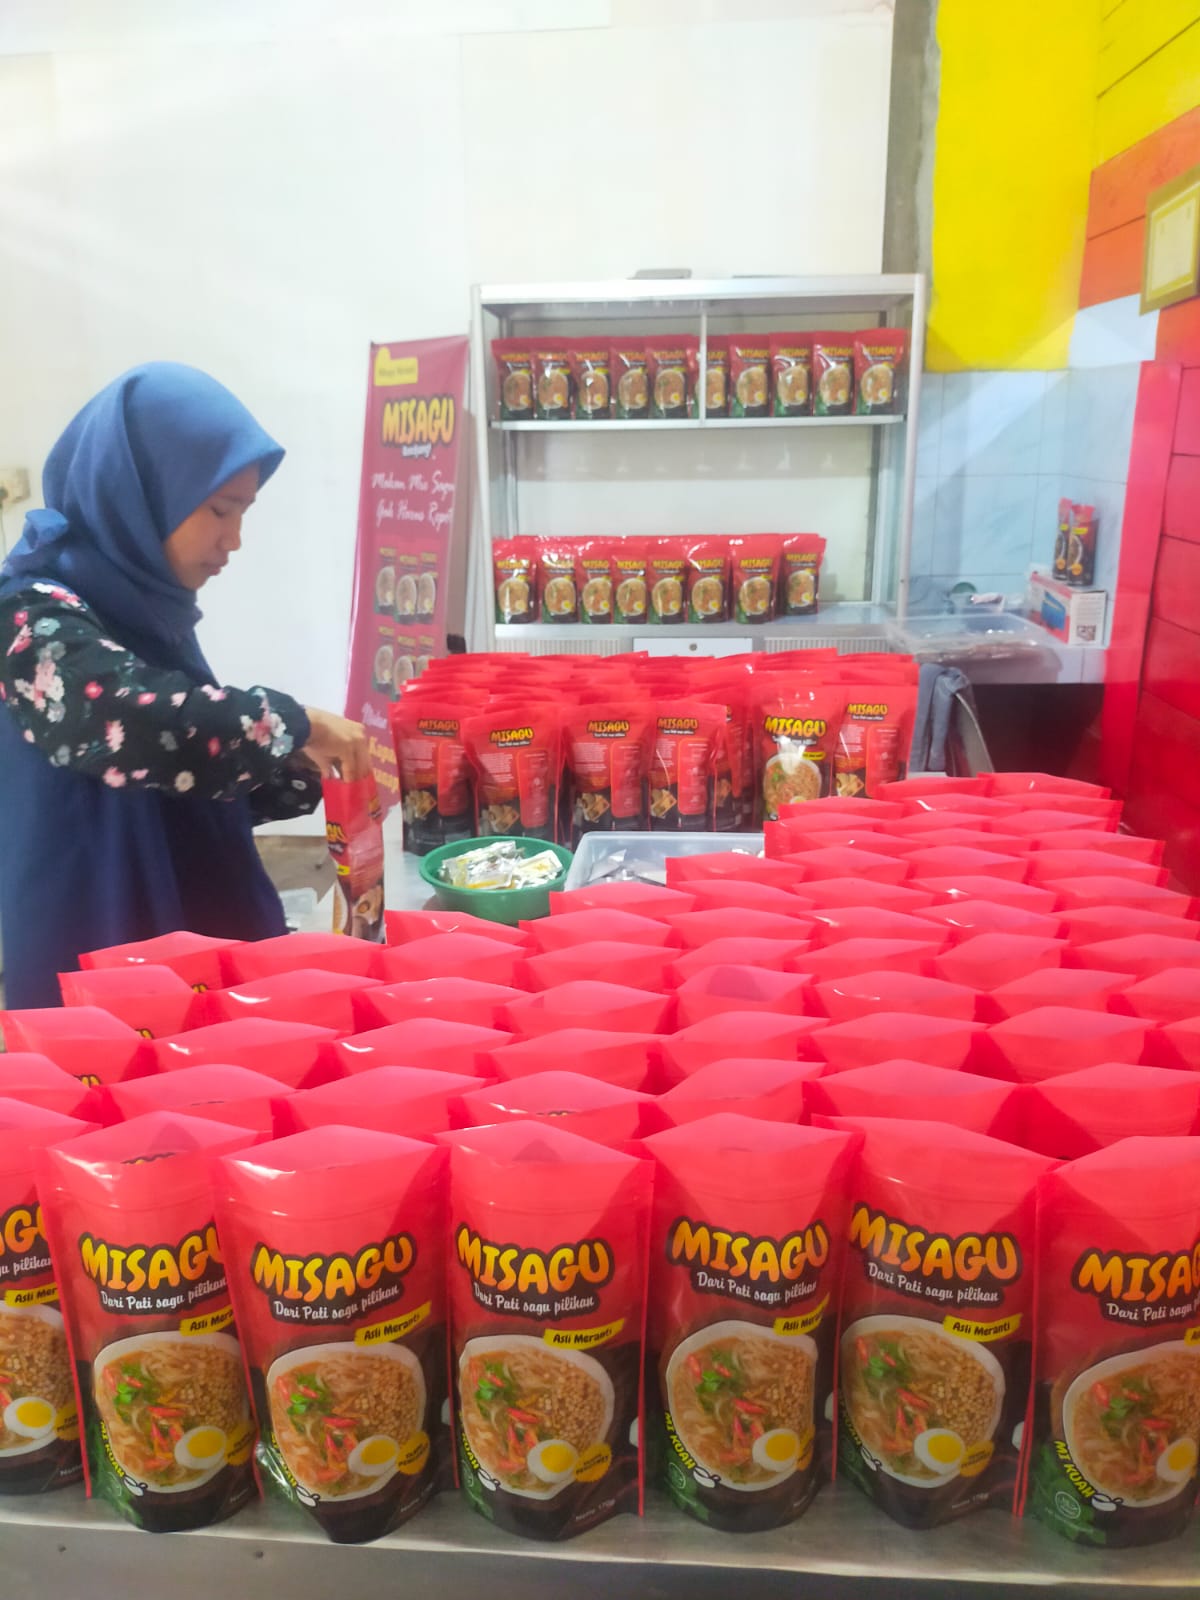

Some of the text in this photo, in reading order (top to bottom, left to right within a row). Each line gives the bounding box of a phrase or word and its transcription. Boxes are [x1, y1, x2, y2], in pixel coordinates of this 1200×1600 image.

[382, 397, 455, 445] MISAGU
[490, 727, 535, 743] MISAGU
[765, 716, 827, 738] MISAGU
[671, 1220, 829, 1283] MISAGU
[850, 1207, 1018, 1281] MISAGU
[254, 1236, 413, 1303] MISAGU
[458, 1227, 610, 1295] MISAGU
[15, 1291, 34, 1304] Asli
[473, 1282, 595, 1316] Dari Pati sagu pilihan
[697, 1271, 725, 1290] Dari
[727, 1279, 751, 1298] Pati
[754, 1290, 781, 1304] sagu
[868, 1262, 999, 1303] Dari Pati sagu pilihan
[101, 1291, 124, 1309] Dari
[126, 1295, 153, 1310] Pati
[156, 1295, 185, 1311] sagu
[274, 1284, 400, 1321] Dari Pati sagu pilihan
[1106, 1303, 1139, 1321] Dari
[1142, 1306, 1167, 1321] Pati
[1169, 1302, 1193, 1320] sagu
[190, 1319, 207, 1332] Asli
[364, 1312, 421, 1342] Asli Meranti
[553, 1328, 613, 1344] Asli Meranti
[953, 1320, 1011, 1337] Asli Meranti
[669, 1434, 696, 1470] KUAH
[1053, 1440, 1071, 1461] MI
[1064, 1463, 1096, 1498] KUAH
